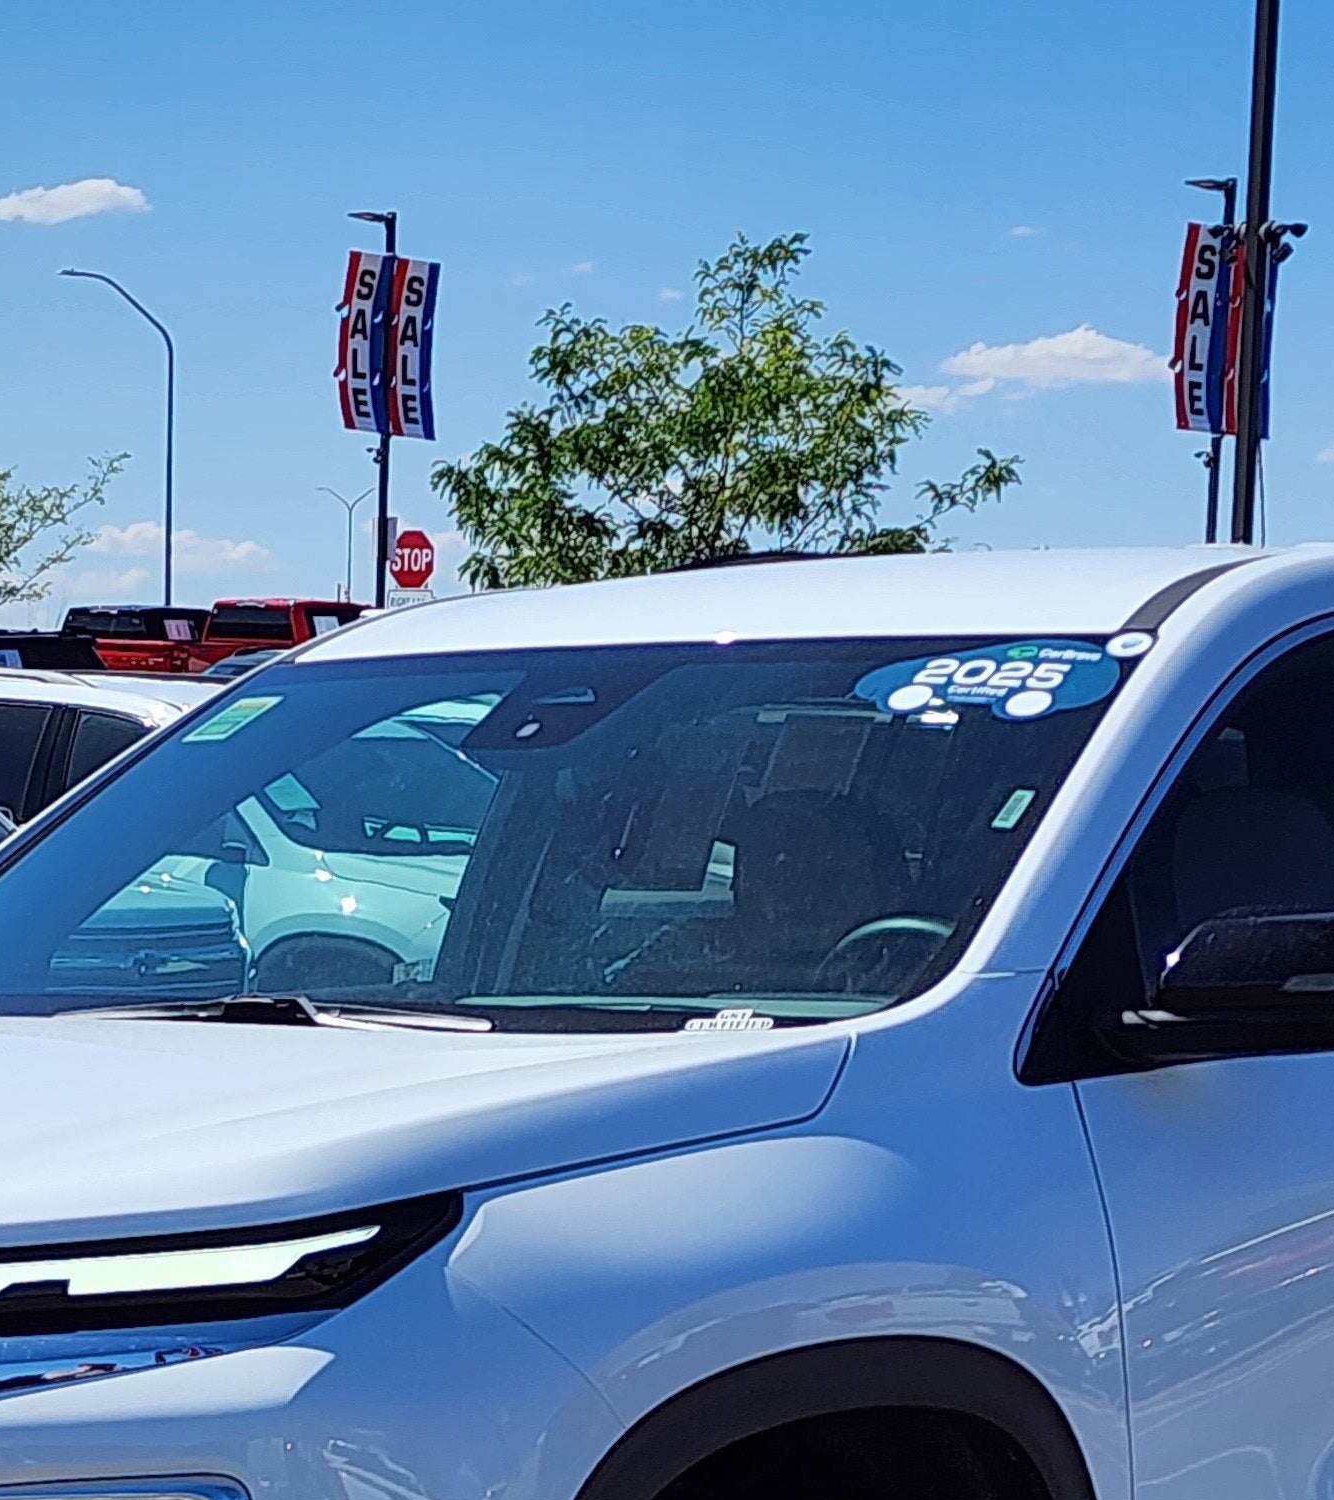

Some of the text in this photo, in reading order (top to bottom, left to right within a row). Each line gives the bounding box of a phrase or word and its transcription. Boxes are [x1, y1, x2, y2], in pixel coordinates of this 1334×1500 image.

[350, 269, 376, 418] SALE
[400, 276, 424, 425] SALE
[1188, 244, 1216, 416] SALE
[392, 547, 432, 572] STOP
[913, 658, 1072, 689] 2025
[947, 685, 1008, 697] Certified
